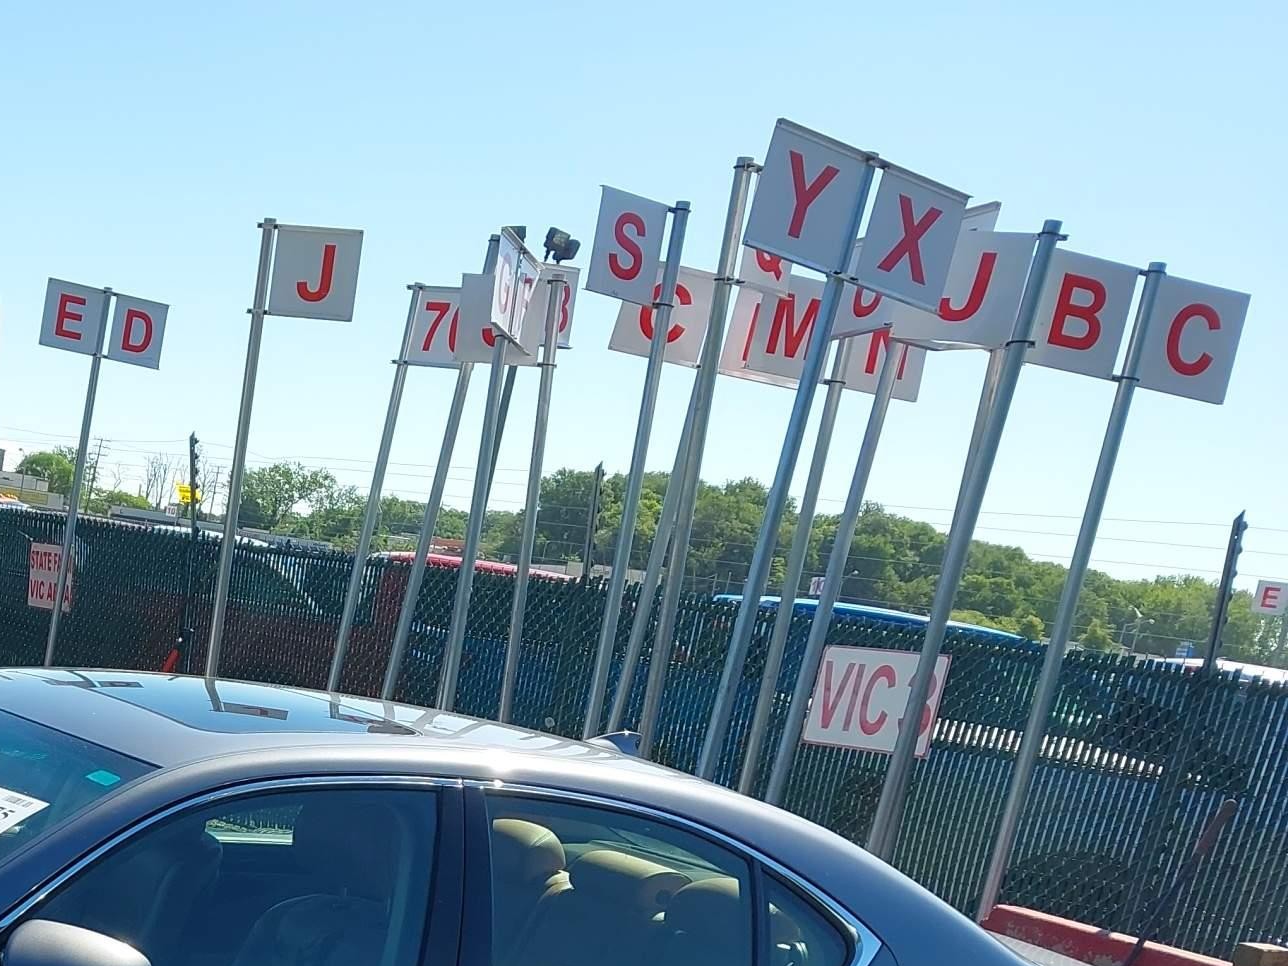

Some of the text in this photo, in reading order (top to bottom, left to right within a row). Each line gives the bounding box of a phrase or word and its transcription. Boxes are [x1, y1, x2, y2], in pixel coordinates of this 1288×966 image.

[787, 149, 841, 240] Y
[296, 244, 336, 302] J
[608, 211, 647, 281] S
[876, 193, 944, 287] X
[55, 292, 87, 341] E
[938, 251, 998, 323] J
[1046, 271, 1107, 352] B
[121, 308, 154, 354] D
[765, 293, 823, 360] M
[1165, 302, 1222, 377] C
[30, 580, 45, 600] VIC
[31, 550, 52, 572] STATE
[1261, 586, 1282, 609] E
[821, 660, 896, 736] VIC
